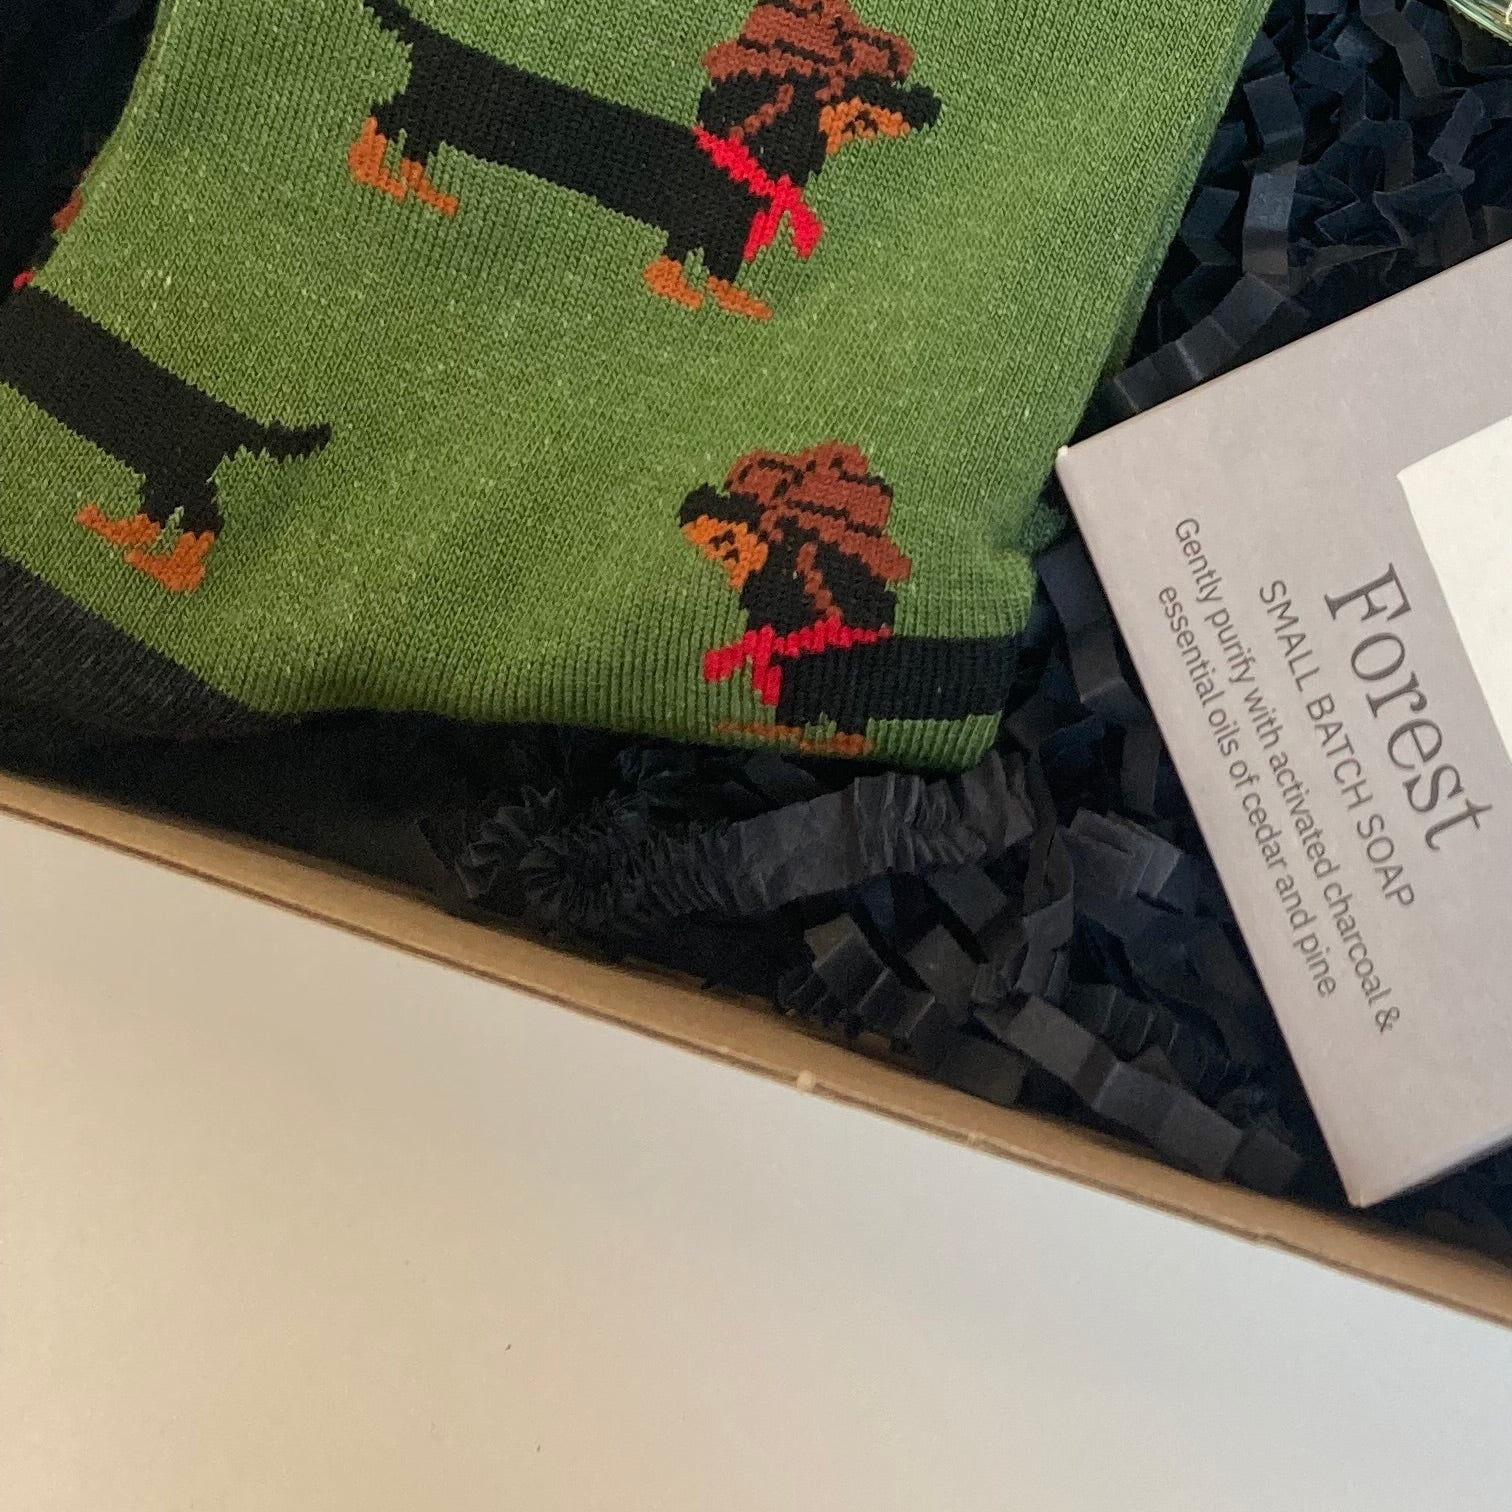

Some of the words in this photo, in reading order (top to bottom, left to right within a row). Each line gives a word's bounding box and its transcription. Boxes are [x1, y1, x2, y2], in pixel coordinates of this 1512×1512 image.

[1158, 586, 1222, 708] essential
[1208, 708, 1240, 757] oils
[1259, 580, 1321, 691] SMALL
[1306, 694, 1373, 812] BATCH
[1357, 815, 1415, 908] SOAP
[1324, 562, 1492, 851] Forest
[1175, 518, 1223, 613] Gently
[1204, 611, 1254, 685] purify
[1243, 688, 1280, 752] with
[1269, 751, 1338, 879] activated
[1323, 878, 1393, 1005] charcoal
[1375, 1007, 1399, 1034] &
[1229, 762, 1254, 792] of
[1241, 791, 1288, 874] cedar
[1275, 873, 1315, 932] and
[1293, 927, 1336, 998] pine
